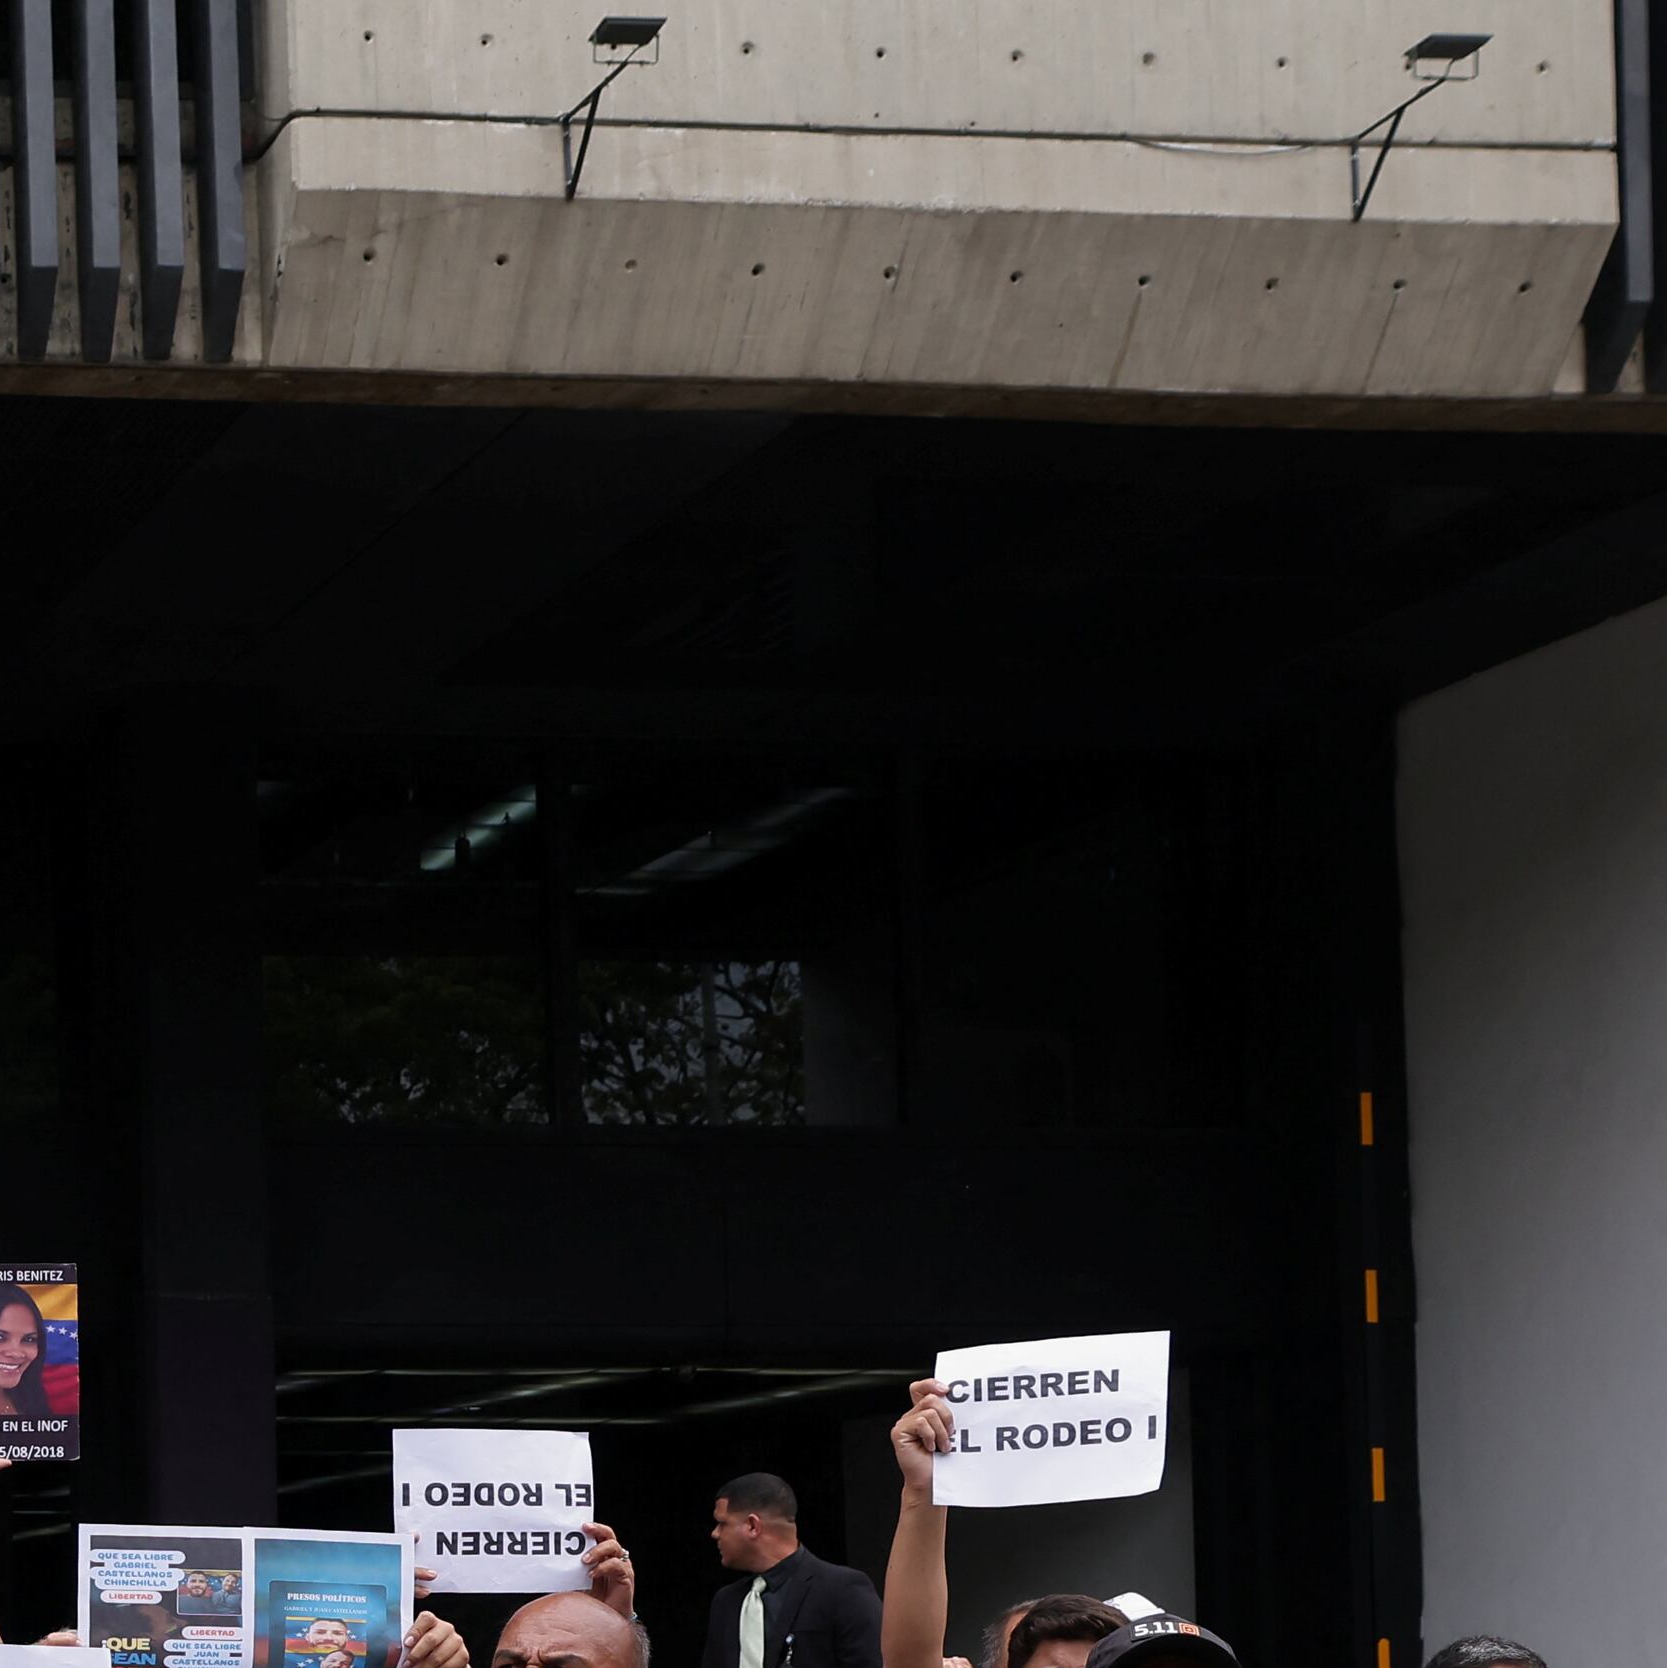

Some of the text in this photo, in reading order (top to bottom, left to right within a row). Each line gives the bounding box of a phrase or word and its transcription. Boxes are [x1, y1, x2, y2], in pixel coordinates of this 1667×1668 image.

[16, 1270, 64, 1282] BENITEZ
[947, 1368, 1120, 1404] CIERREN
[2, 1420, 18, 1432] EN
[21, 1420, 35, 1432] EL
[37, 1419, 69, 1432] INOF
[995, 1417, 1133, 1451] RODEO
[424, 1482, 543, 1507] RODEO
[555, 1483, 592, 1507] EL
[436, 1531, 586, 1555] CIERREN
[97, 1552, 119, 1560] QUE
[144, 1553, 173, 1561] LIBRE
[98, 1570, 173, 1578] CASTELLANOS
[104, 1579, 167, 1587] CHINCHILLA
[1134, 1622, 1178, 1637] 5.11
